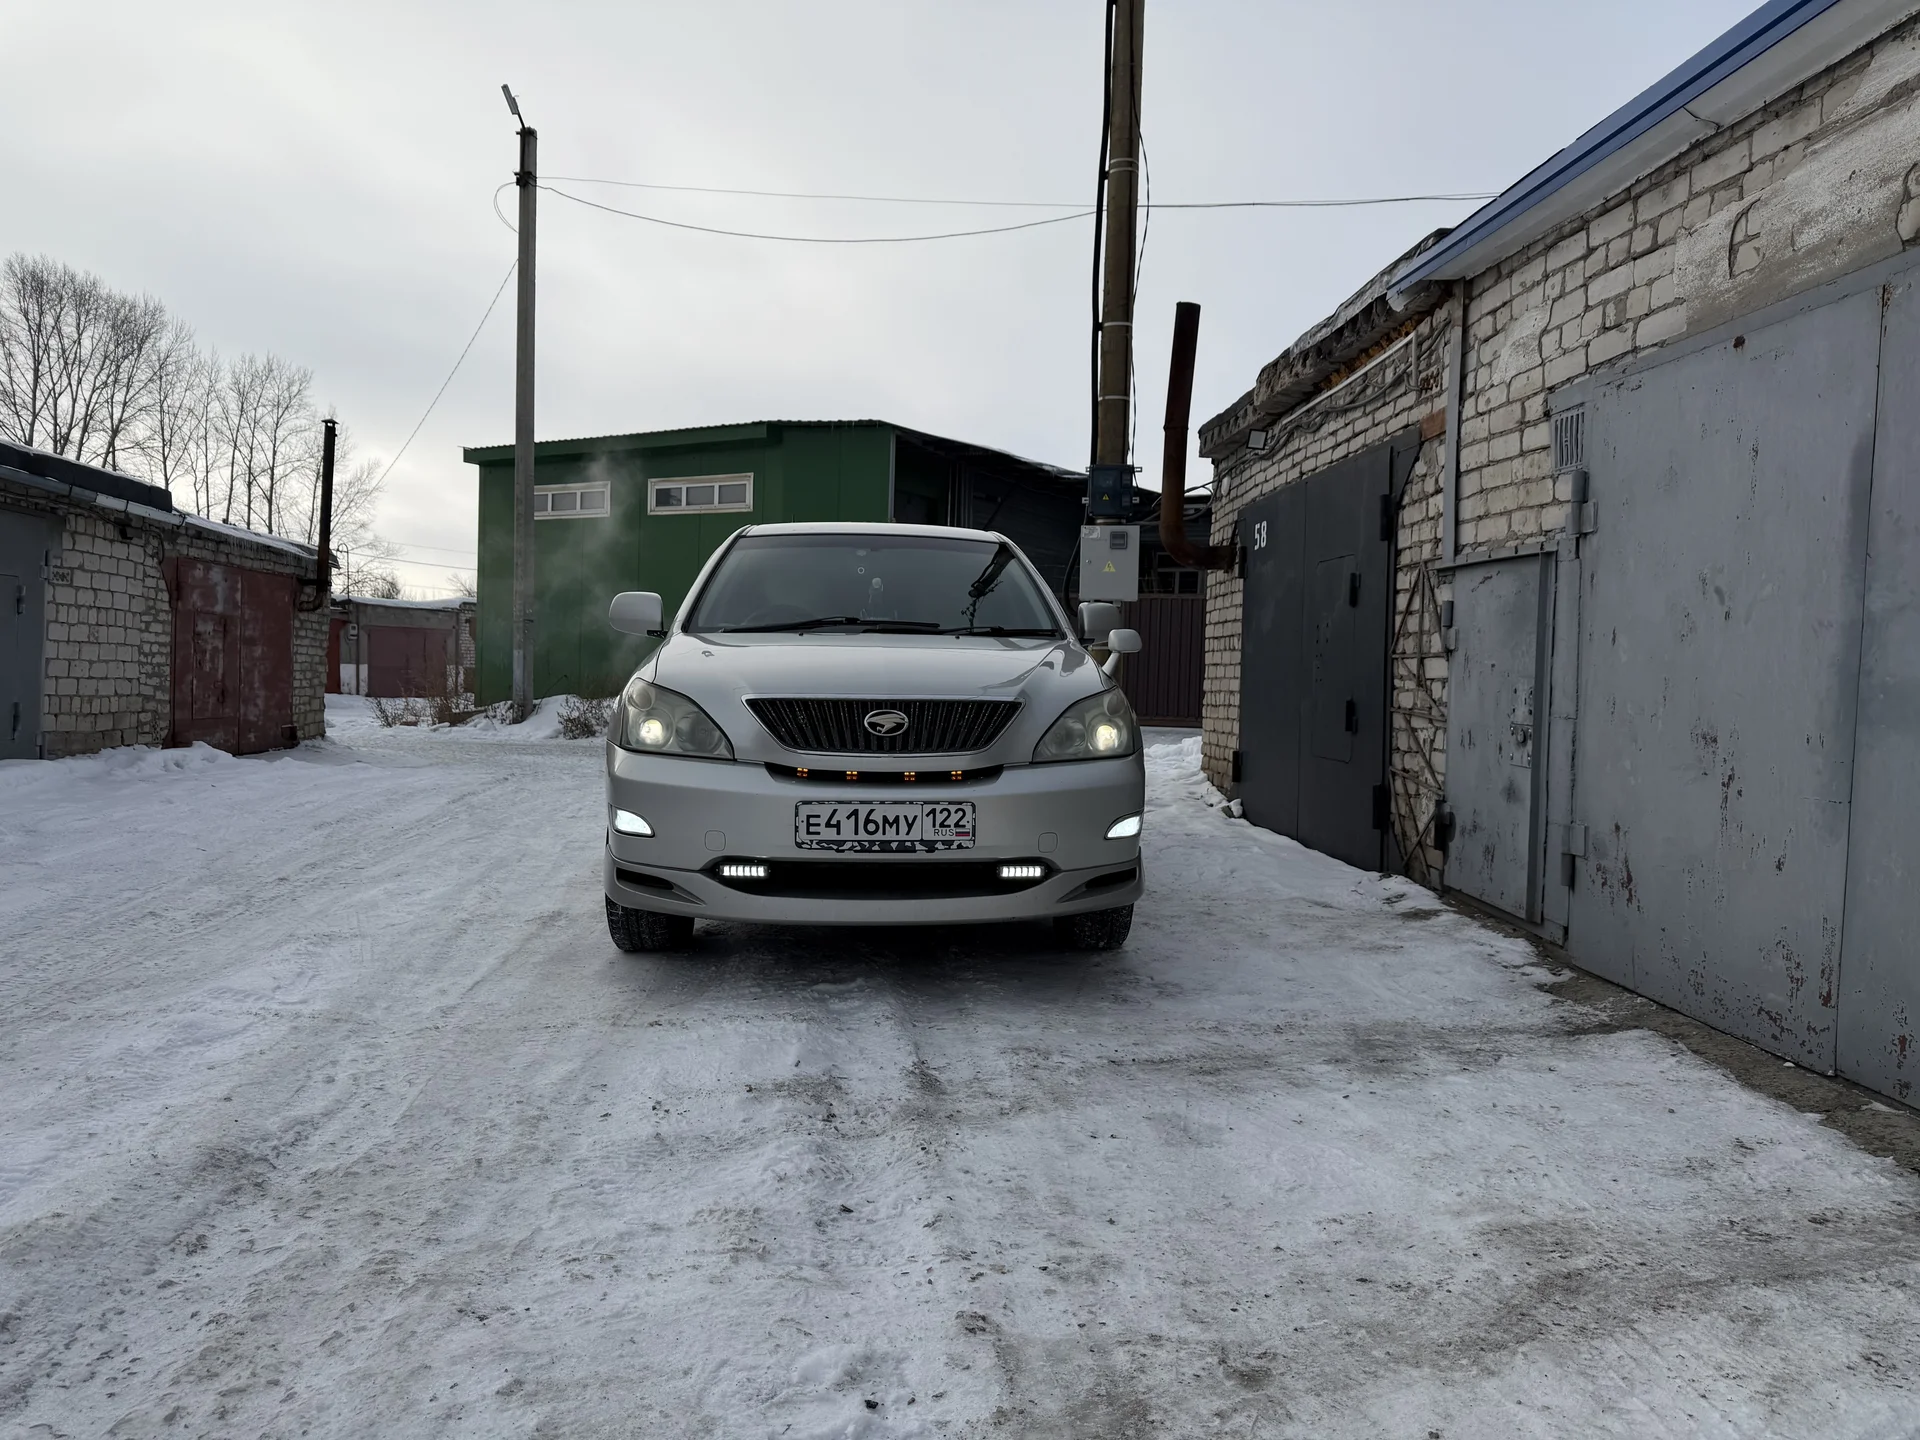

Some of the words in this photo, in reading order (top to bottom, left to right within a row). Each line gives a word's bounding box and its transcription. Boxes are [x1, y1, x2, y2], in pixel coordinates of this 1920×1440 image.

[1254, 520, 1267, 551] 58
[925, 807, 967, 829] 122
[933, 828, 955, 837] RUS
